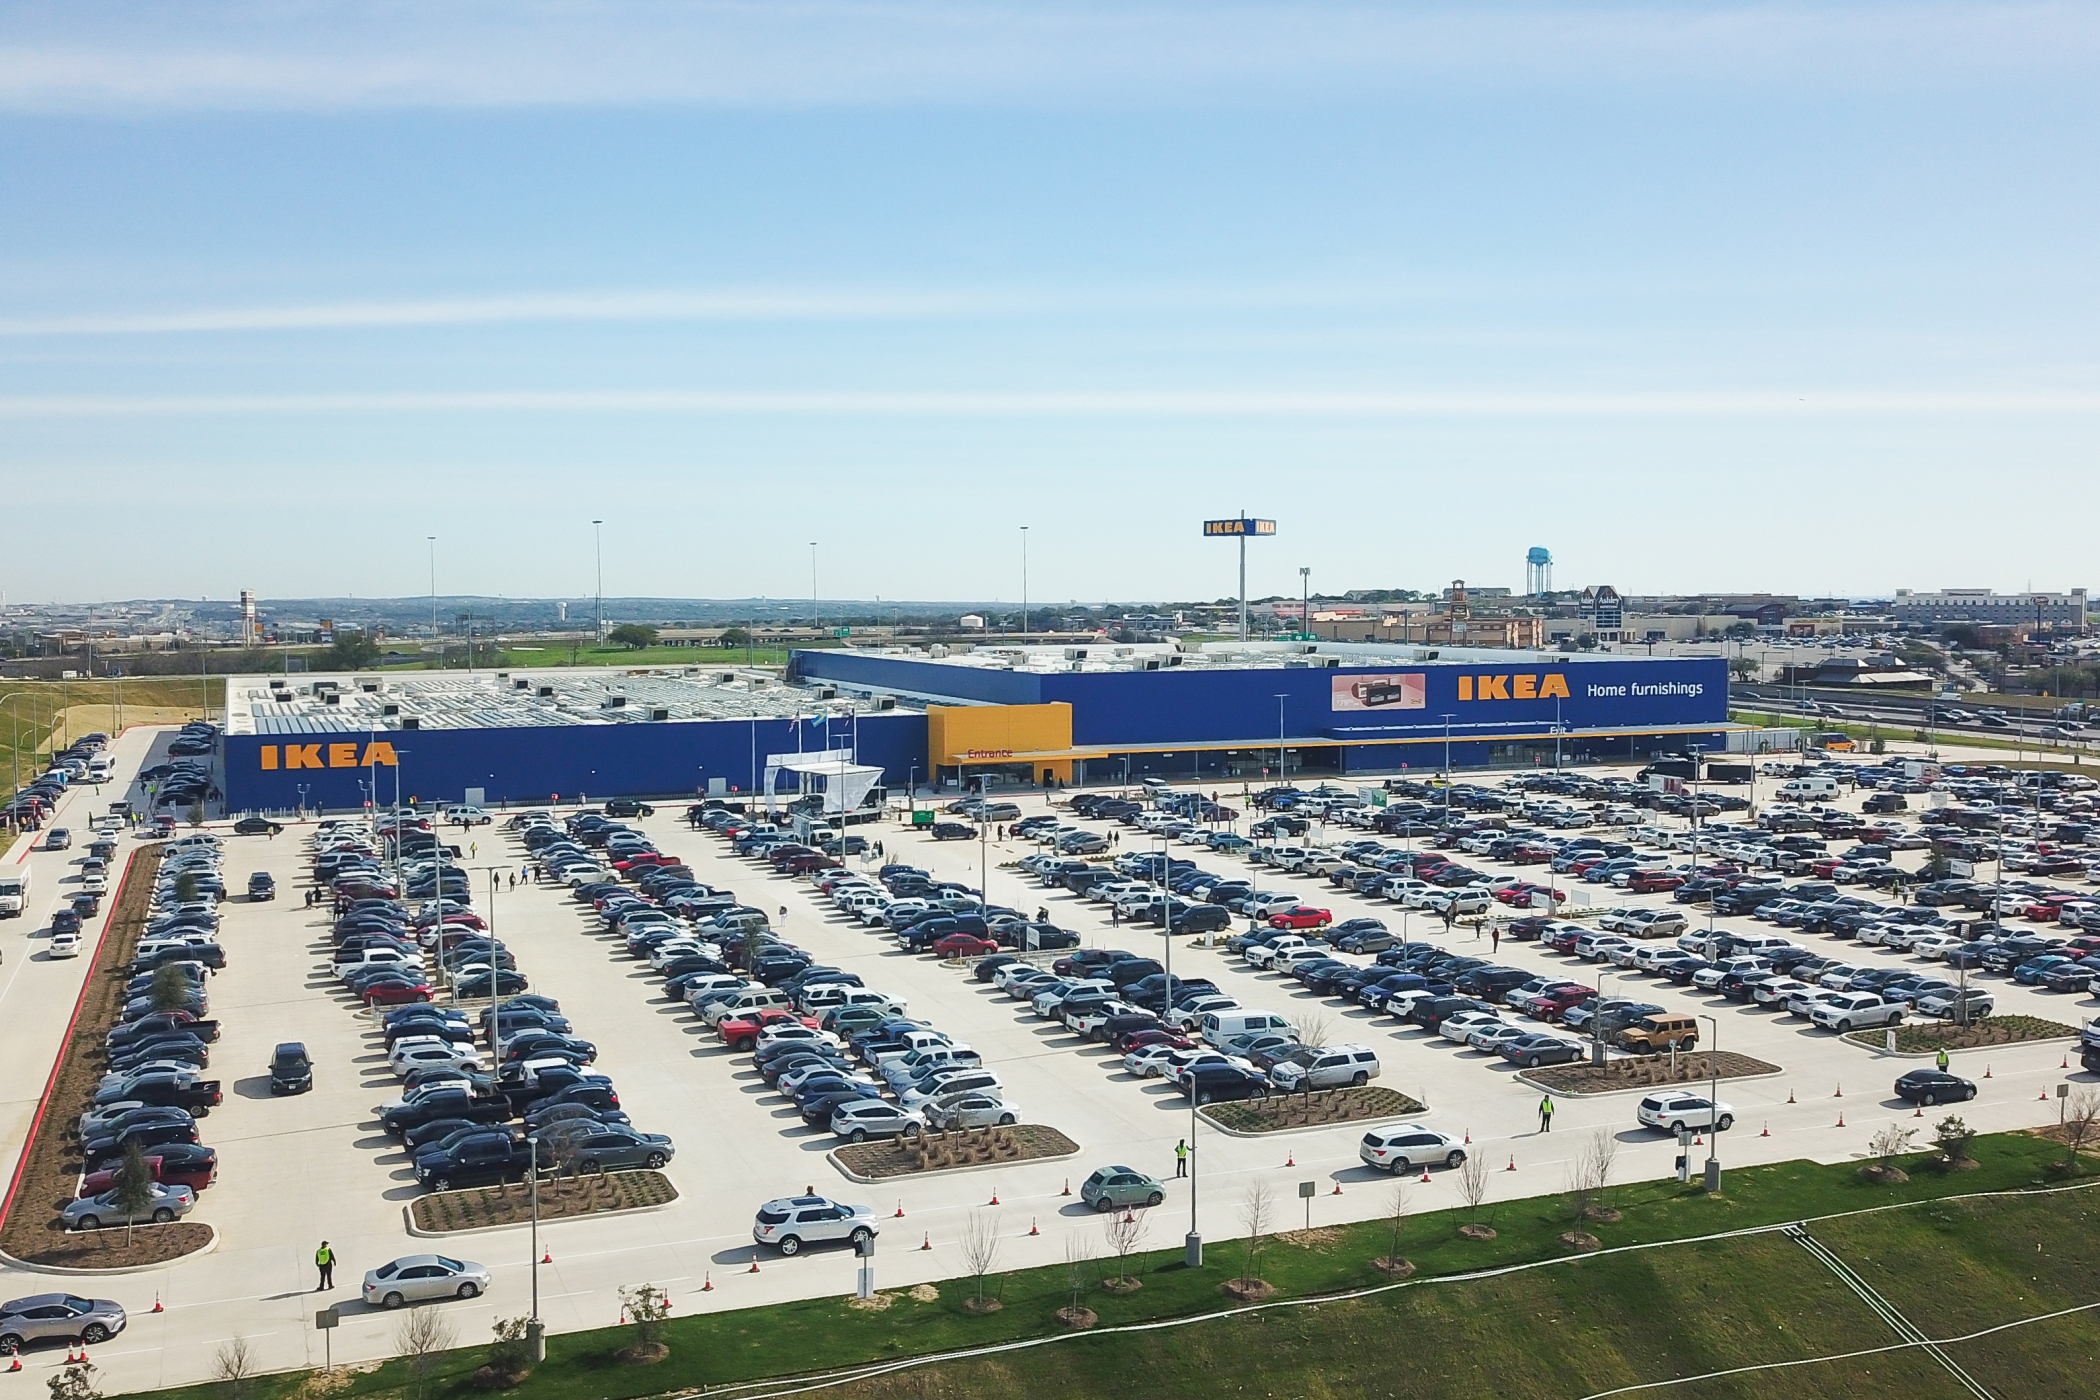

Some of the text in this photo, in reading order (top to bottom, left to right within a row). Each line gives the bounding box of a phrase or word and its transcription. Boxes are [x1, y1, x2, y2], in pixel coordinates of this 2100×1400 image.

[1206, 521, 1245, 533] IKEA
[1256, 521, 1275, 533] IKEA
[1599, 596, 1619, 605] Ashley
[1458, 673, 1571, 701] IKEA
[1587, 682, 1703, 697] Home furnishings
[260, 742, 400, 770] IKEA
[967, 749, 1013, 758] Entrance
